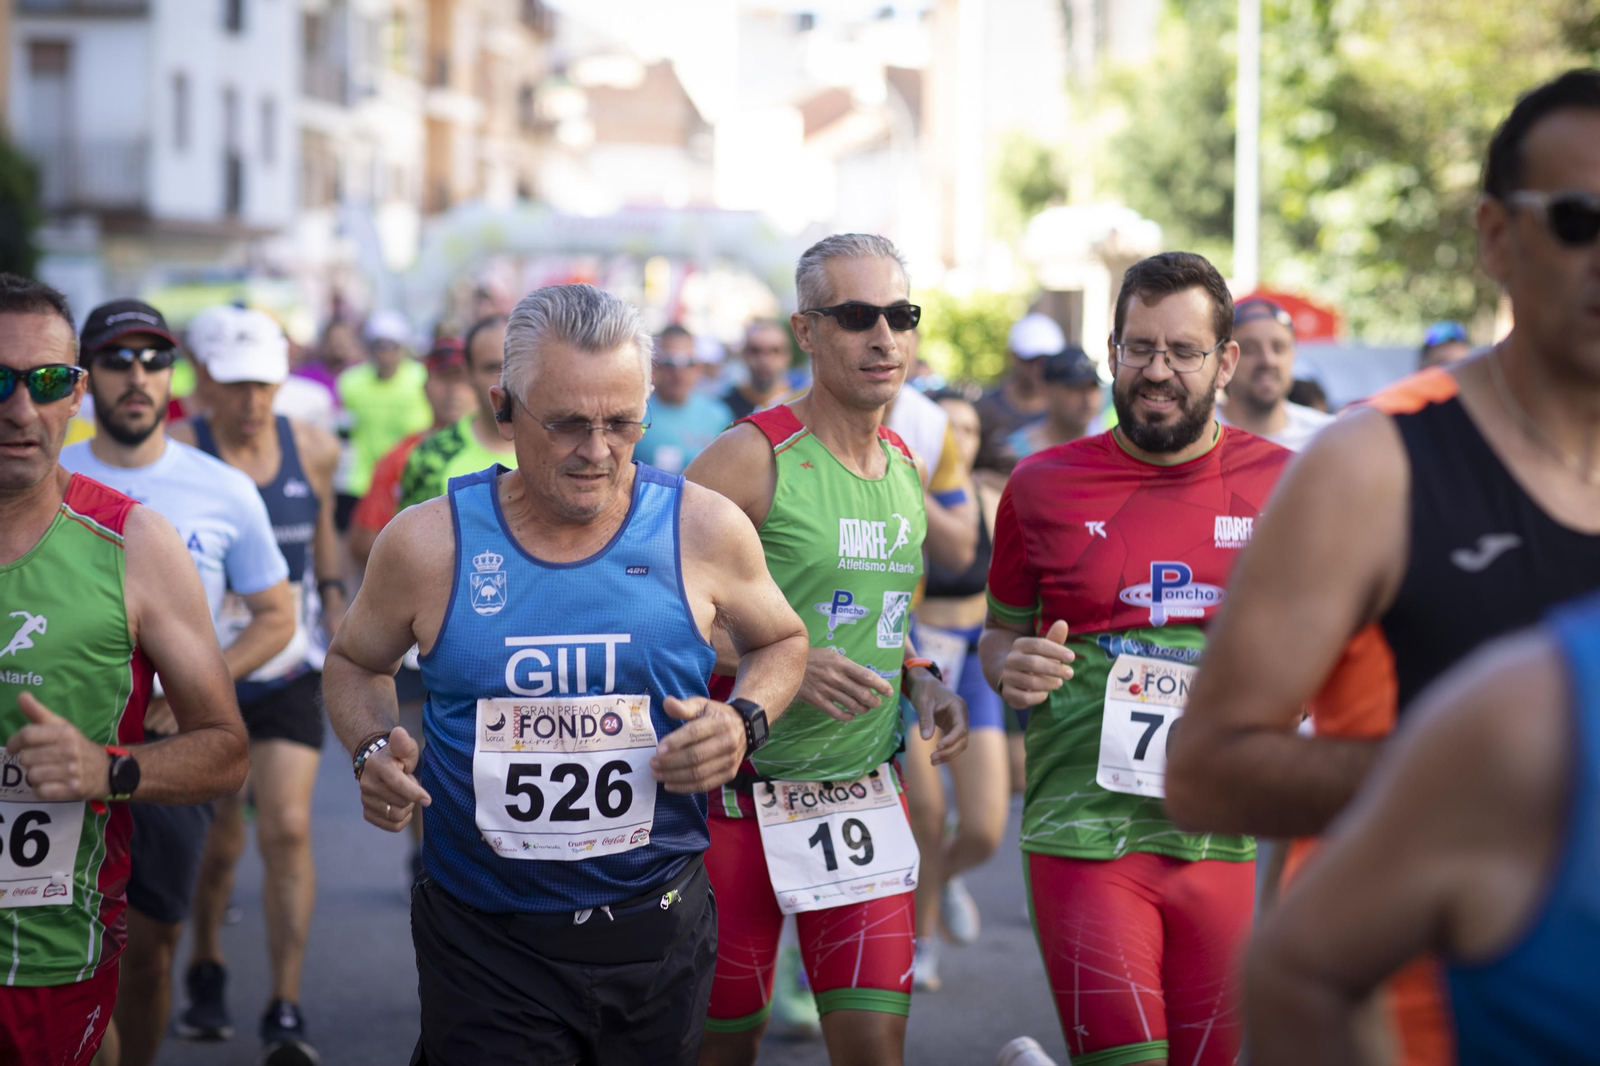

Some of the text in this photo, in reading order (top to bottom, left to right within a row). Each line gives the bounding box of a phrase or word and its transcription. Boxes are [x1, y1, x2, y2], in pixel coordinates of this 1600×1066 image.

[838, 518, 887, 559] ATARFE
[837, 557, 915, 574] Atletismo Atarfe
[1151, 562, 1214, 603] Poncho
[831, 590, 865, 615] Poncho
[1144, 673, 1190, 697] FON
[520, 705, 555, 716] GRAN
[558, 704, 601, 716] PREMIO
[519, 713, 623, 740] FONDO
[604, 719, 618, 730] 24
[1130, 711, 1185, 761] 7
[505, 760, 633, 822] 526
[0, 809, 51, 868] 6
[568, 838, 597, 848] Cruzcampo
[808, 818, 874, 872] 19
